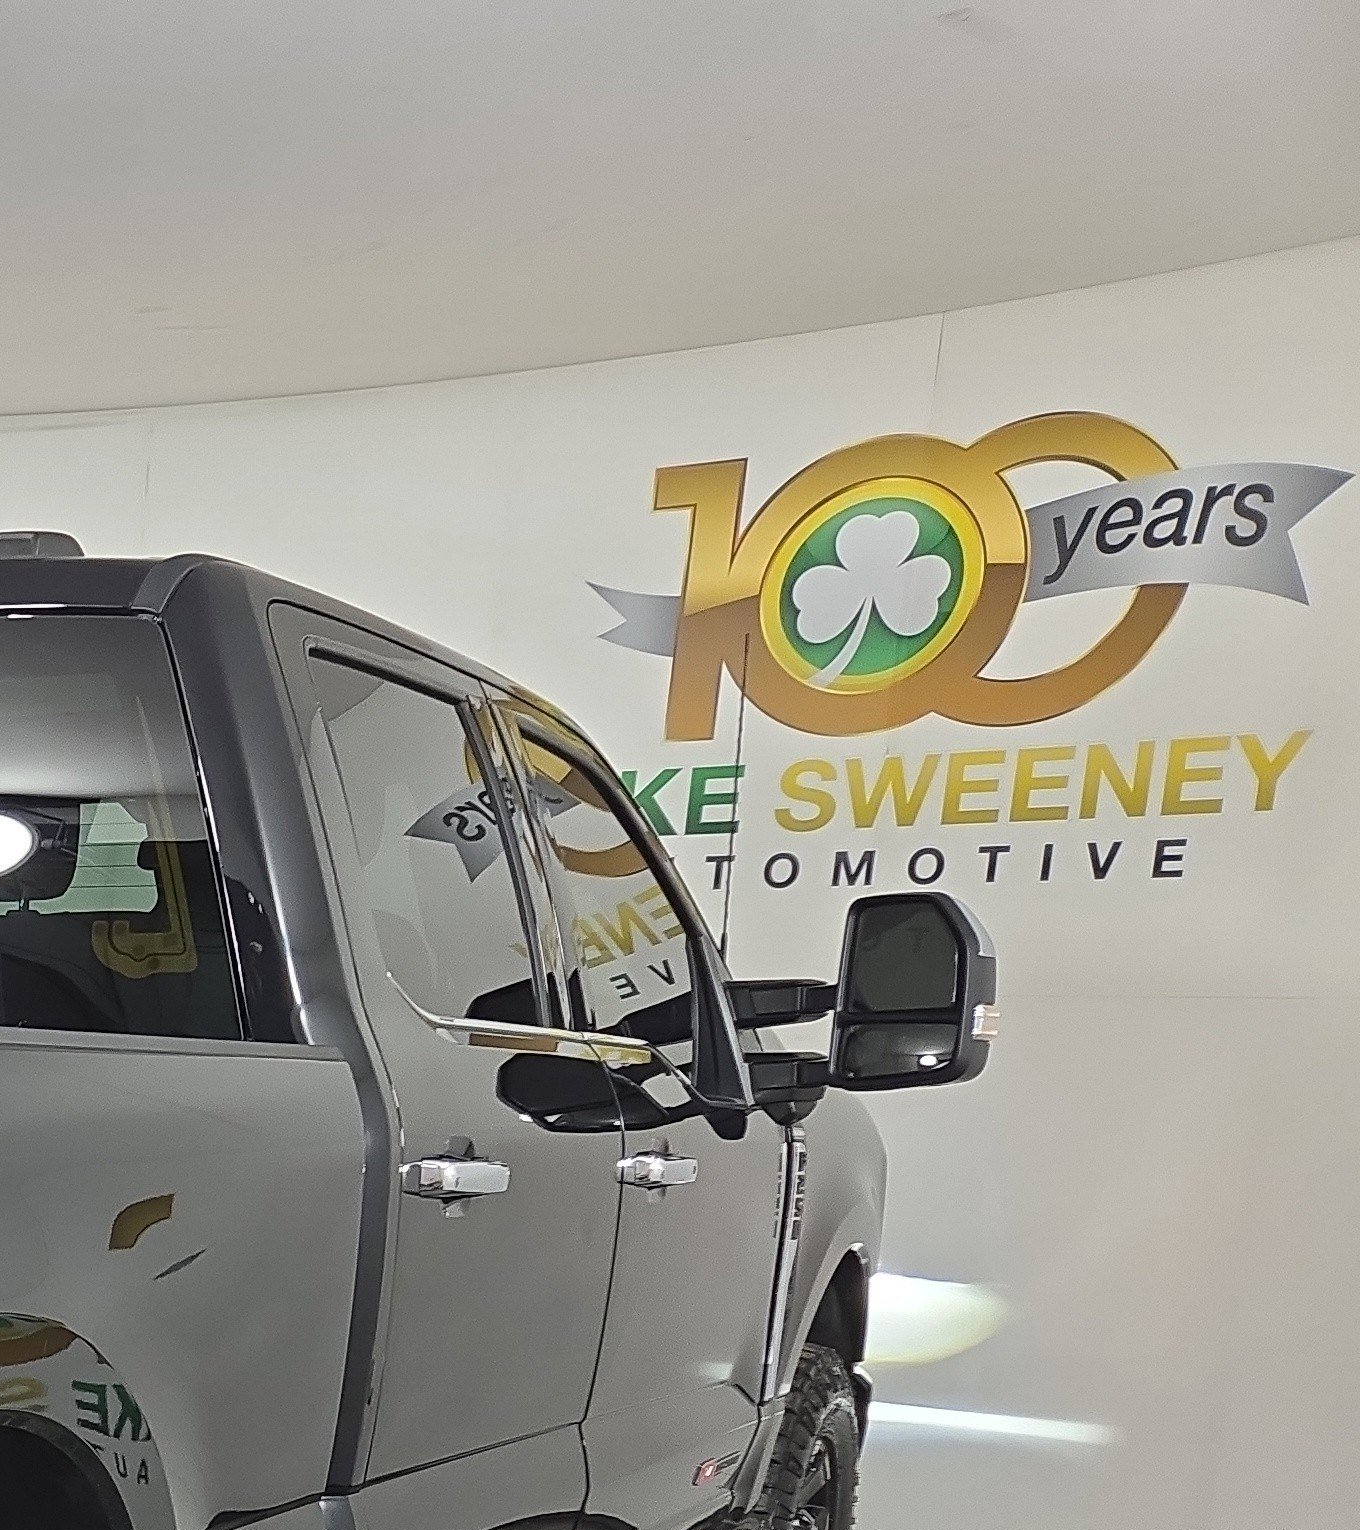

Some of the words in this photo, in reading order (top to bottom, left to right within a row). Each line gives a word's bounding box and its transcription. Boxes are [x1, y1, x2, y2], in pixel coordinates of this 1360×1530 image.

[1042, 482, 1275, 586] years
[621, 763, 747, 836] KE
[772, 729, 1316, 834] SWEENEY
[702, 838, 1188, 890] TOMOTIVE
